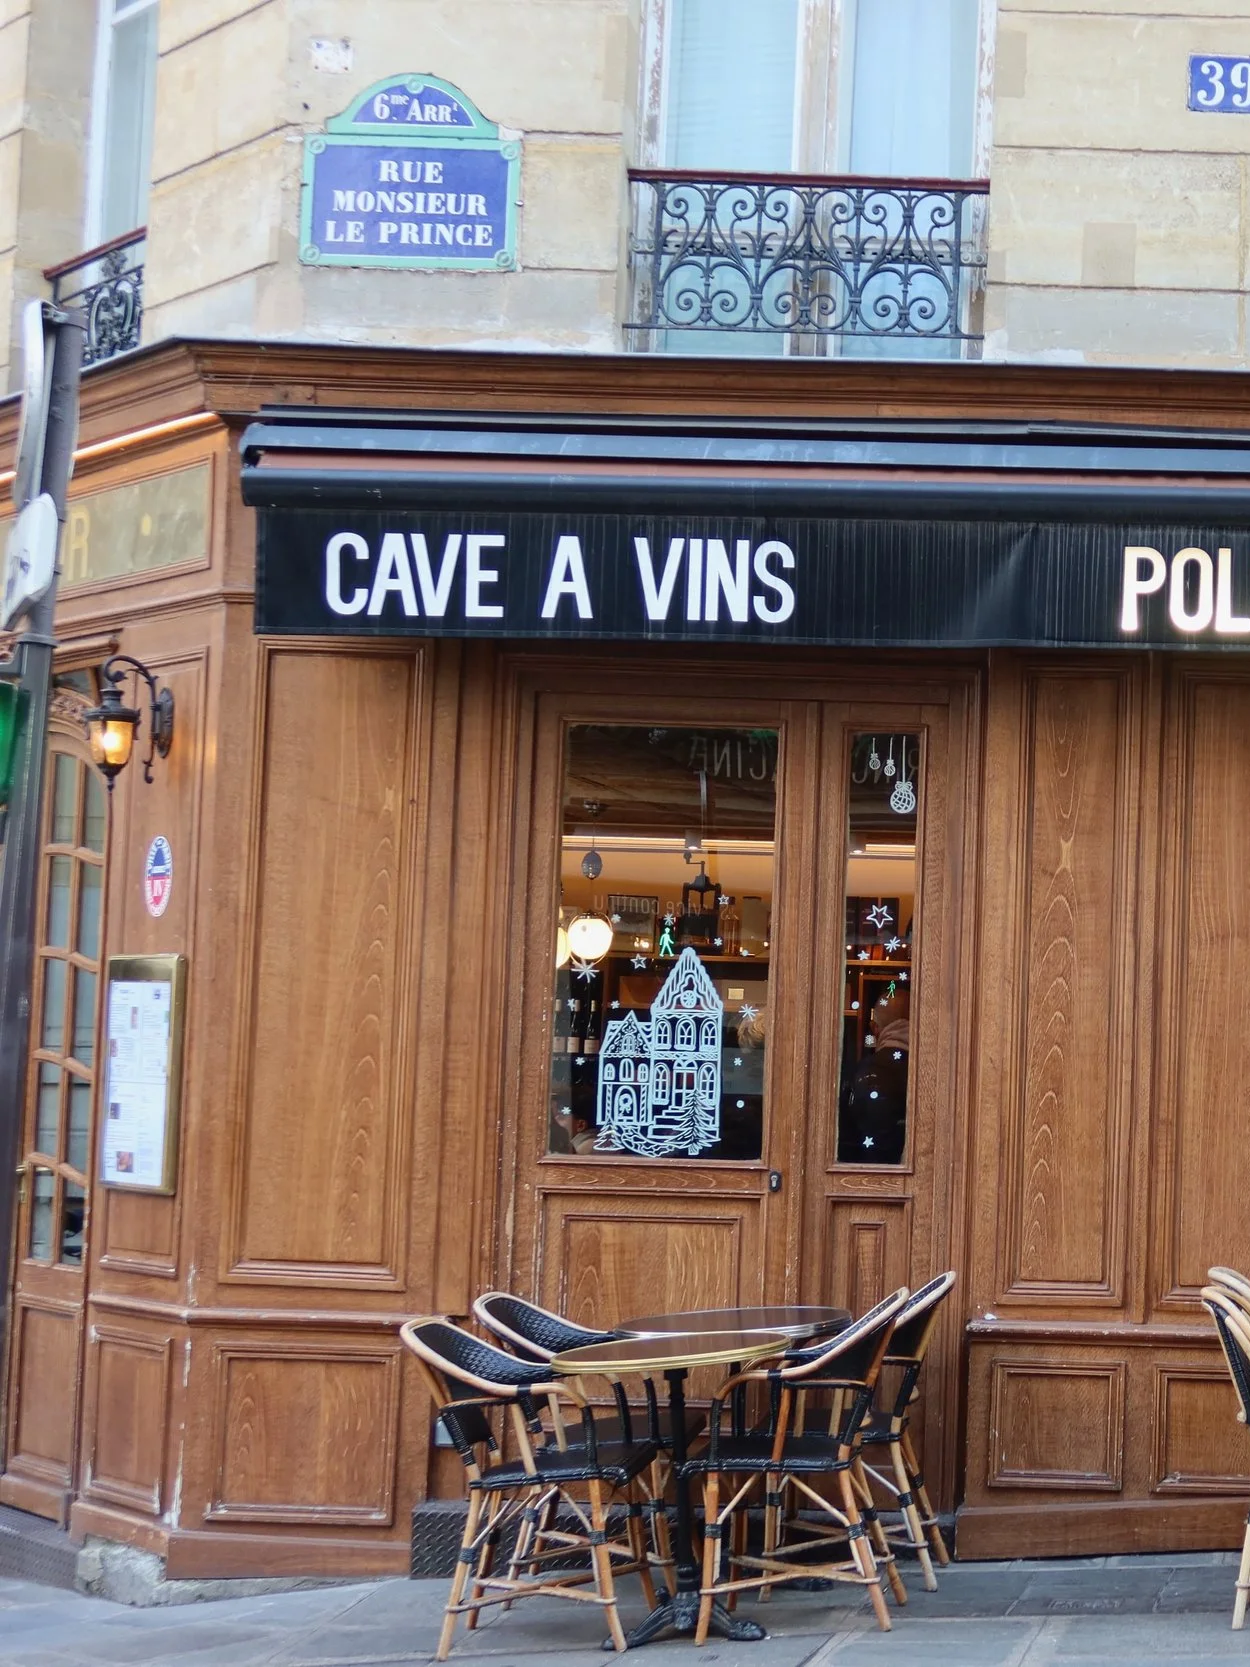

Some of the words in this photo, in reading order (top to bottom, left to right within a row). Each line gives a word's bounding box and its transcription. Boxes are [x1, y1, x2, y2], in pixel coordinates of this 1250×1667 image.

[378, 160, 444, 184] RUE
[332, 189, 488, 216] MONSIEUR
[325, 220, 365, 243] LE
[378, 221, 494, 247] PRINCE
[325, 531, 506, 618] CAVE
[541, 535, 594, 619] A
[633, 536, 796, 624] VINS
